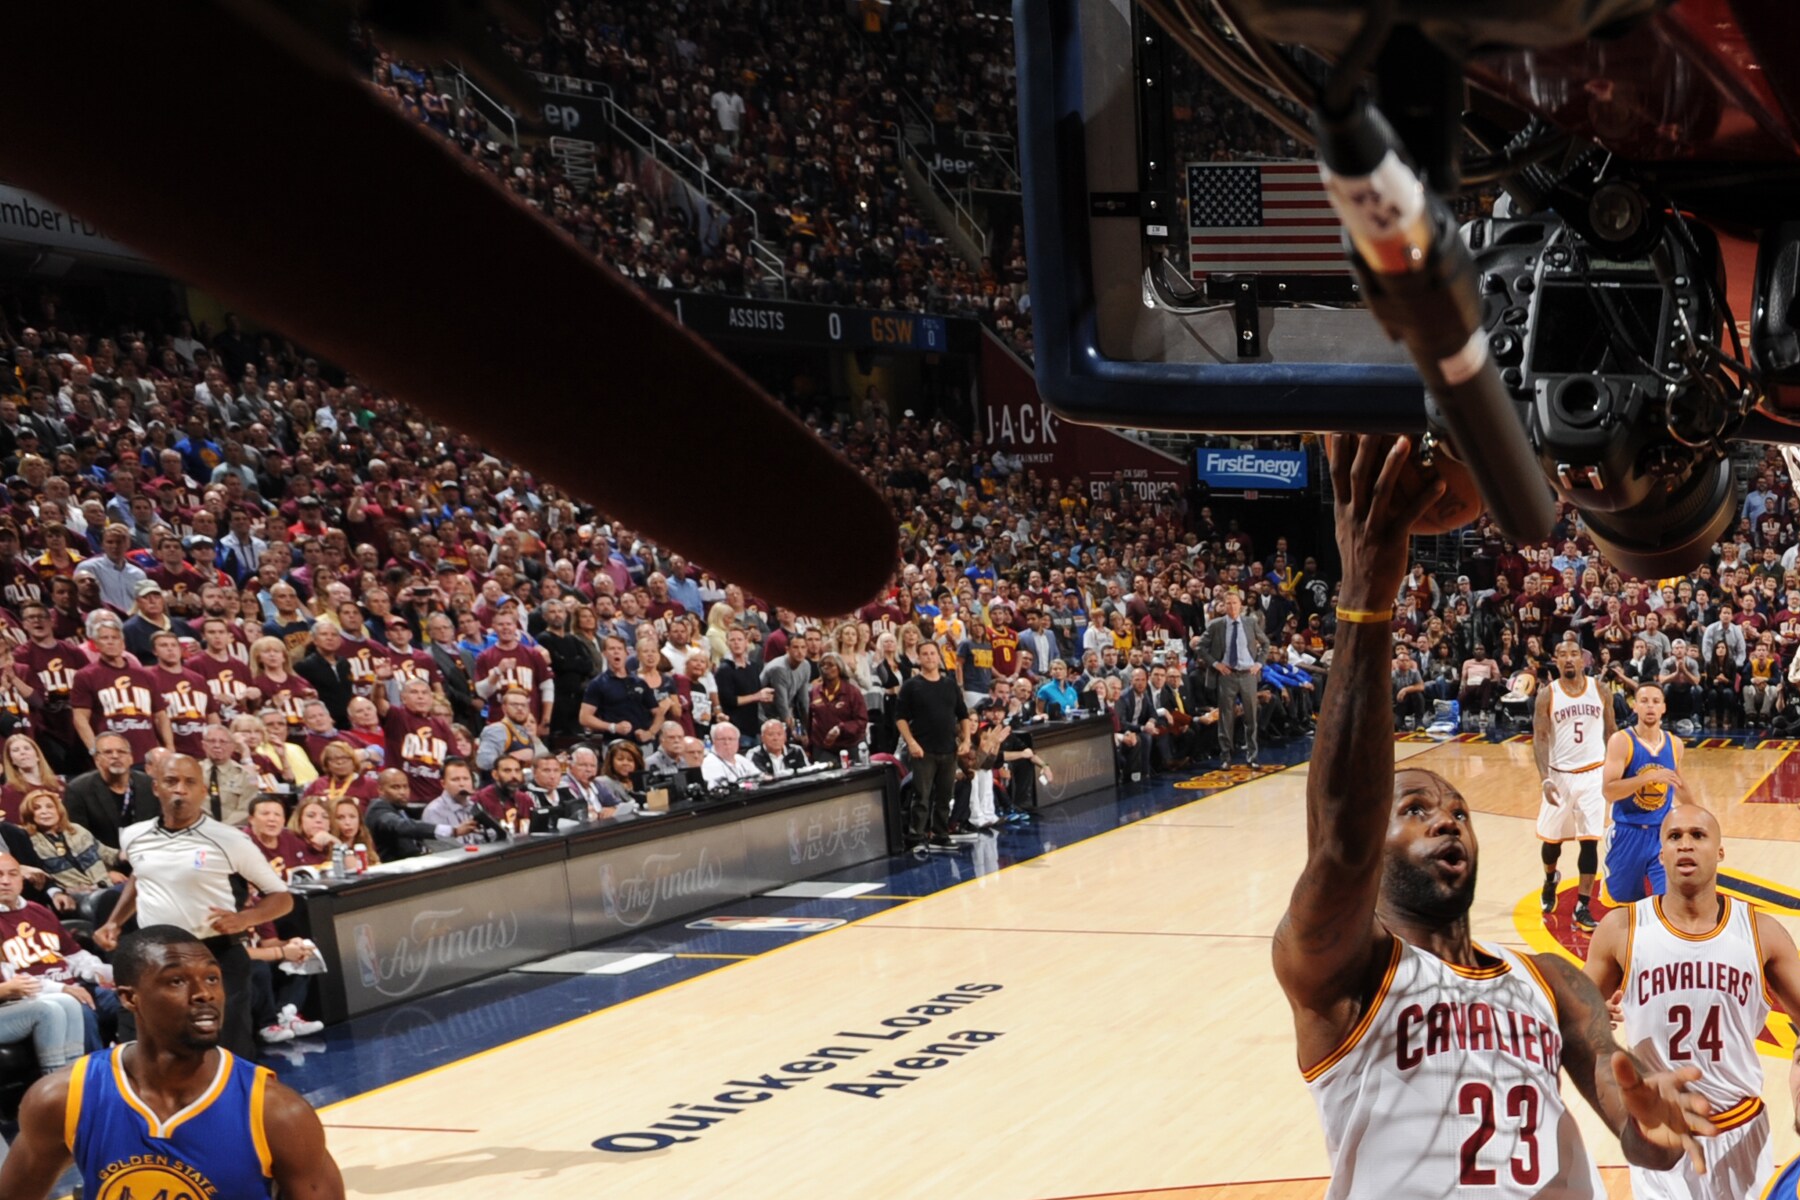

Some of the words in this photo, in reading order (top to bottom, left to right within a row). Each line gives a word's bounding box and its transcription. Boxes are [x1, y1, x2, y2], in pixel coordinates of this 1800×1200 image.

[927, 153, 975, 174] Jee
[0, 198, 62, 232] mber
[729, 307, 785, 330] ASSISTS
[829, 312, 842, 340] 0
[870, 316, 913, 345] GSW
[1206, 453, 1301, 478] FirstEnergy
[1554, 703, 1602, 724] CAVALIERS
[1574, 721, 1584, 744] 5
[620, 877, 650, 913] The
[632, 847, 722, 920] Finals
[1638, 961, 1753, 1007] CAVALIERS
[1668, 1004, 1723, 1062] 24
[591, 1045, 872, 1153] Quicken
[833, 982, 1004, 1040] Loans
[824, 1028, 1006, 1099] Arena
[1458, 1082, 1540, 1186] 23
[99, 1154, 168, 1181] GOLDEN
[173, 1160, 219, 1197] STATE
